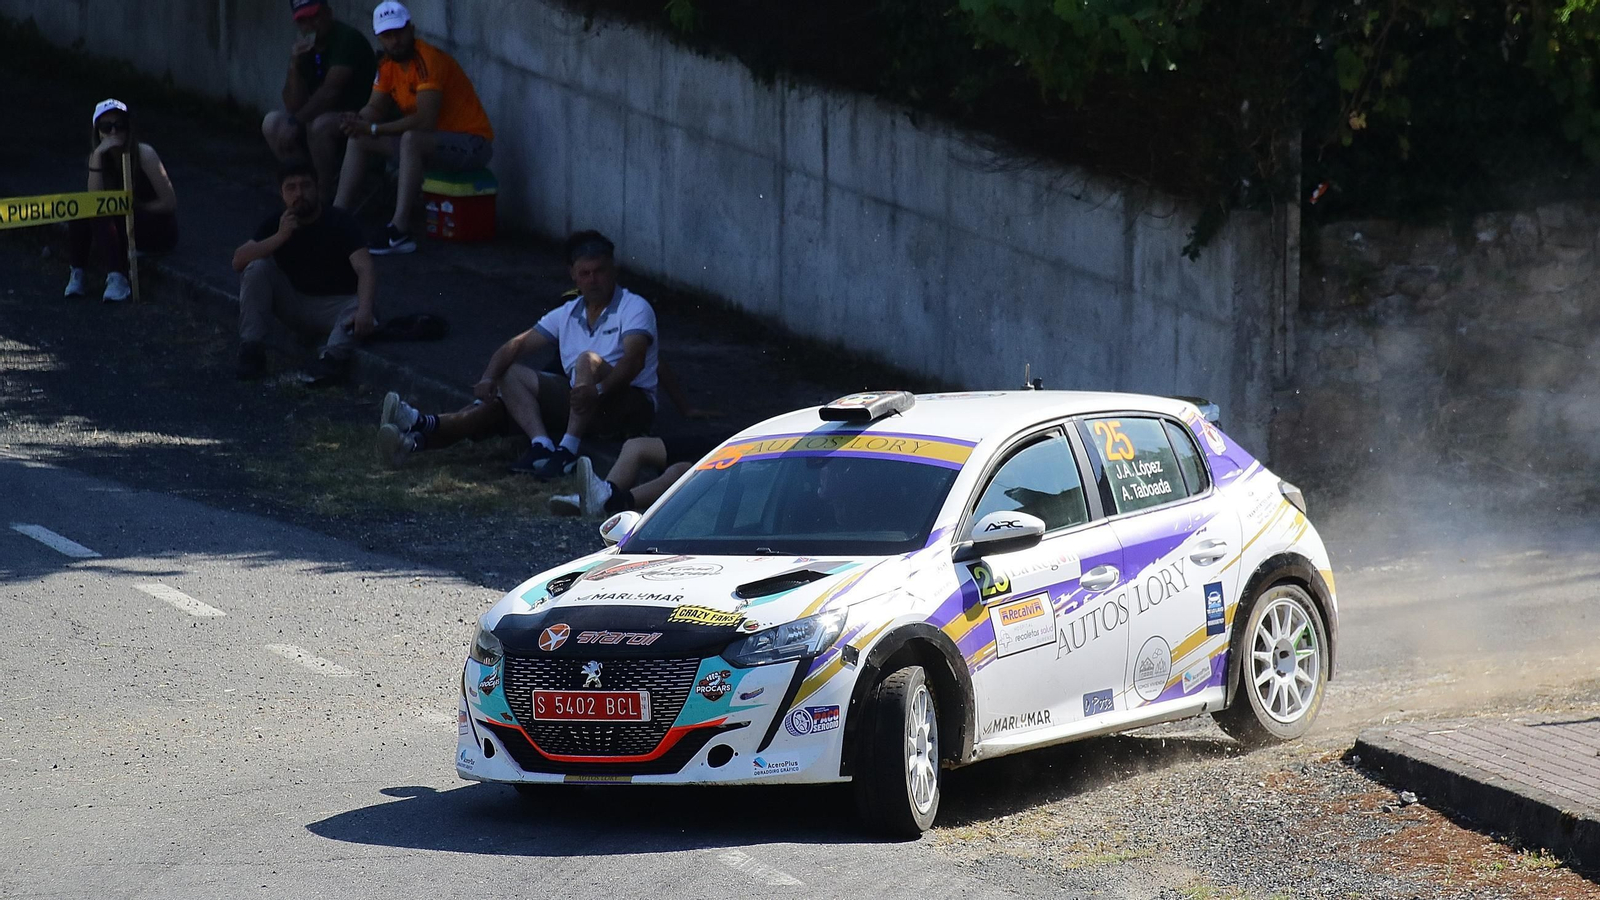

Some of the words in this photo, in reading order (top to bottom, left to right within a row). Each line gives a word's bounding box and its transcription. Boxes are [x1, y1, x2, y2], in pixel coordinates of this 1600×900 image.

[8, 199, 79, 223] PUBLICO
[1094, 420, 1136, 461] 25
[694, 444, 755, 471] 25
[745, 437, 844, 455] AUTOS
[847, 436, 931, 454] LORY
[1116, 463, 1134, 479] J.A.
[1132, 460, 1163, 478] López
[1122, 486, 1133, 501] A.
[1130, 479, 1172, 499] Taboada
[984, 520, 1023, 532] ARC
[679, 608, 709, 621] CRAZY
[710, 613, 736, 622] FANS
[1009, 602, 1036, 620] Recalvi
[1056, 593, 1129, 660] AUTOS
[1133, 557, 1189, 615] LORY
[695, 684, 731, 694] PROCARS
[537, 697, 545, 714] S
[555, 697, 595, 715] 5402
[606, 697, 637, 715] BCL
[813, 709, 839, 724] PACO
[993, 709, 1051, 734] MARLUMAR
[768, 760, 798, 769] AceroPlus
